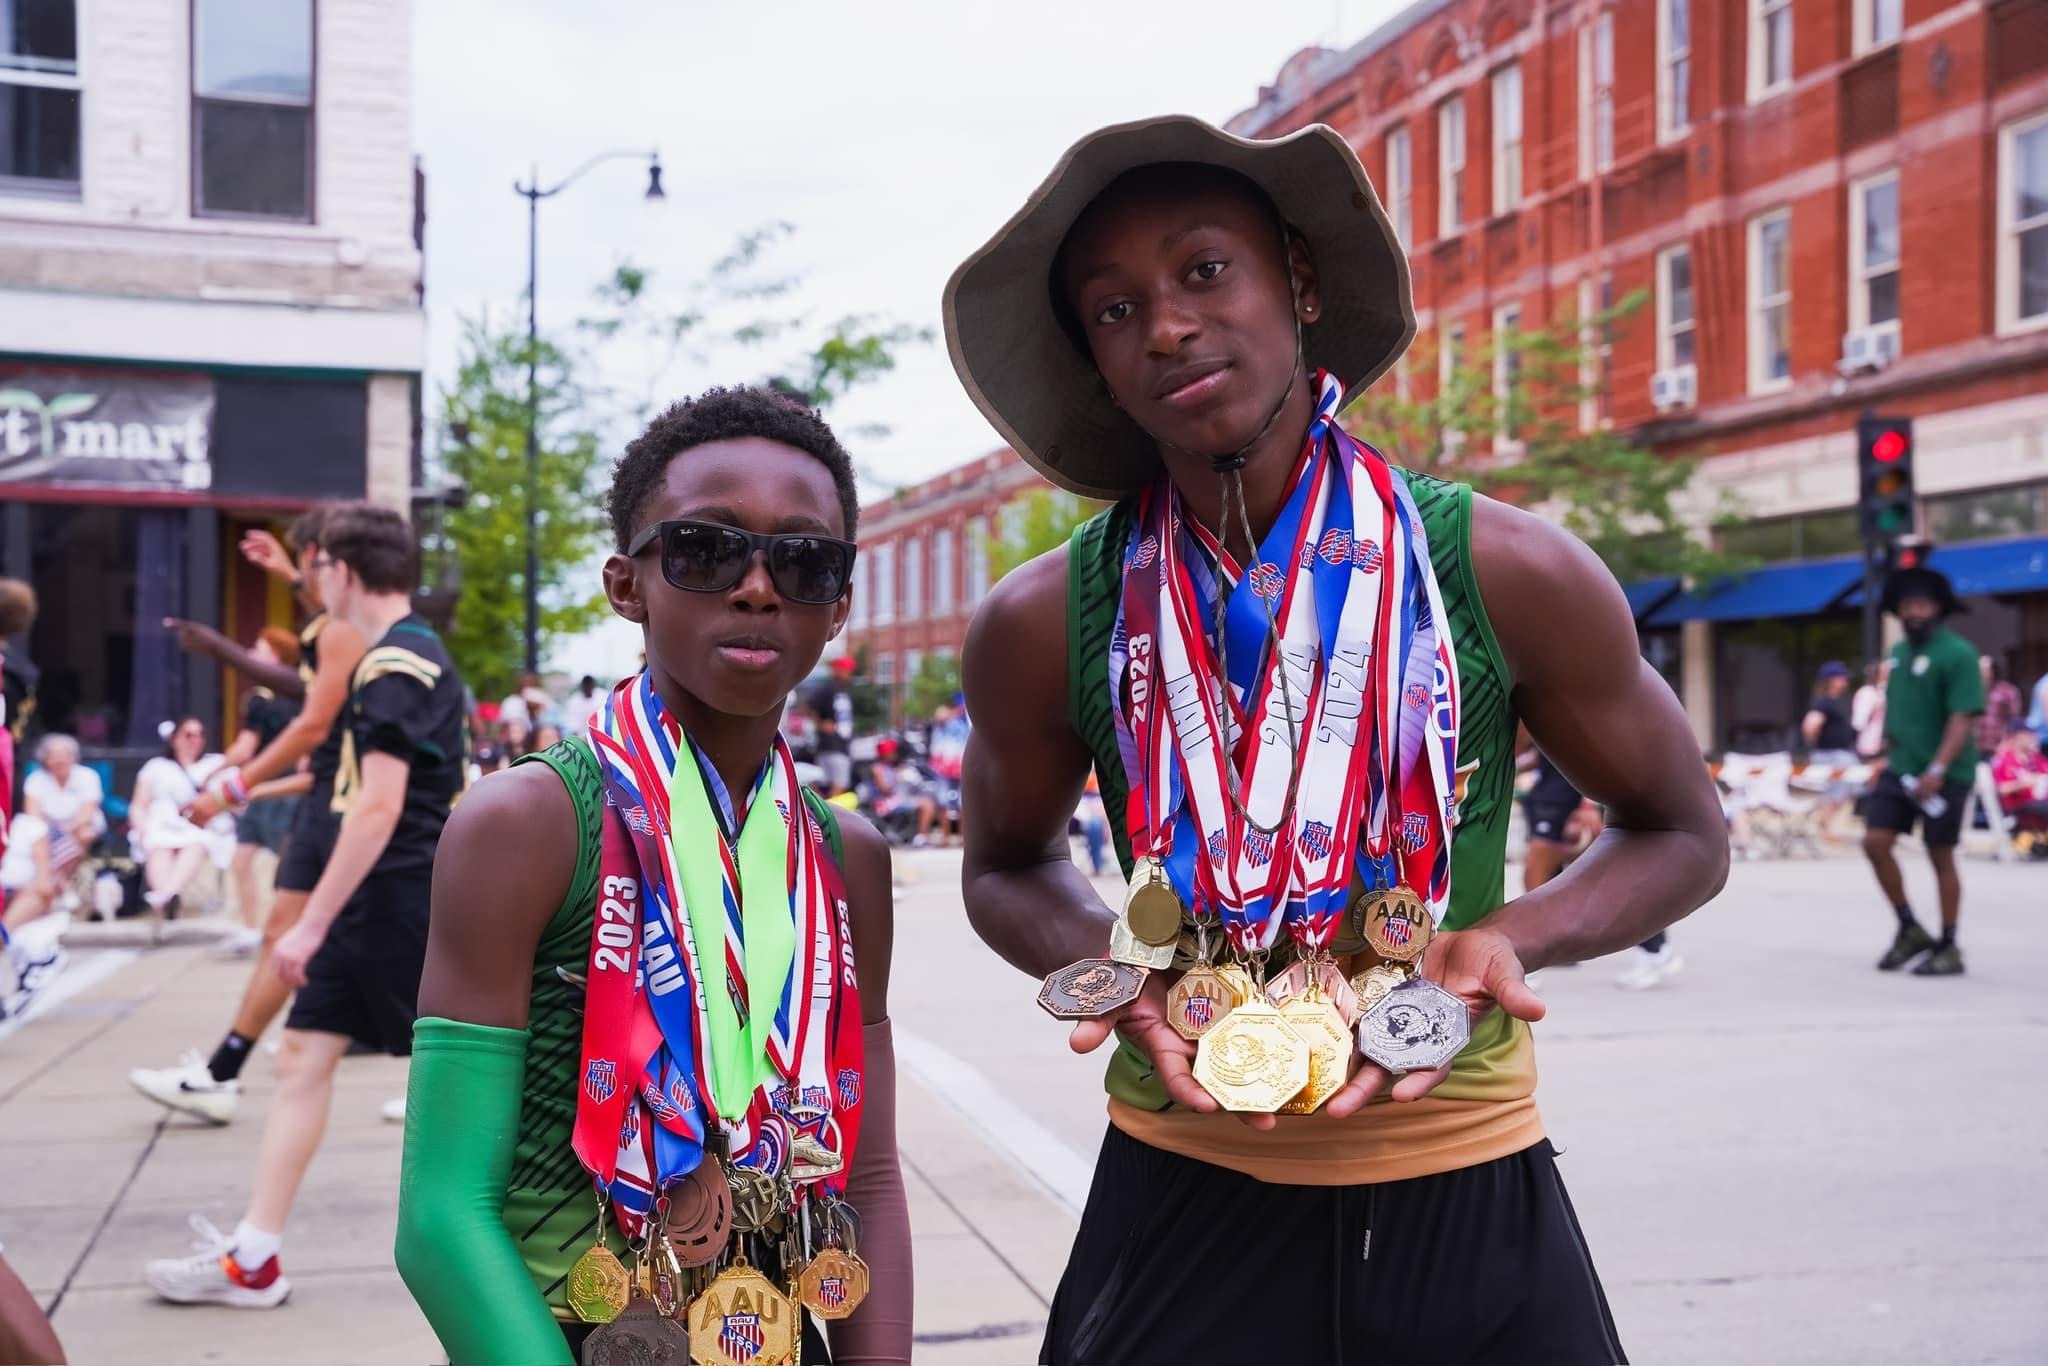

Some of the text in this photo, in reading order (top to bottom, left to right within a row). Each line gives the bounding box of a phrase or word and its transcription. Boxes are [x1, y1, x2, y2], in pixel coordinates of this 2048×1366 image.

[61, 414, 209, 462] mart
[1129, 633, 1151, 722] 2023
[1259, 639, 1319, 752] 2024
[1317, 639, 1372, 748] 2024
[1165, 671, 1212, 760] AAU
[1248, 838, 1266, 862] USA
[1306, 833, 1323, 854] USA
[595, 875, 638, 974] 2023
[1373, 899, 1425, 927] AAU
[643, 920, 686, 996] AAU
[838, 899, 858, 991] 2023
[1175, 979, 1223, 1008] AAU
[700, 1285, 779, 1332] AAU
[730, 1317, 753, 1326] AAU
[728, 1328, 754, 1353] USA
